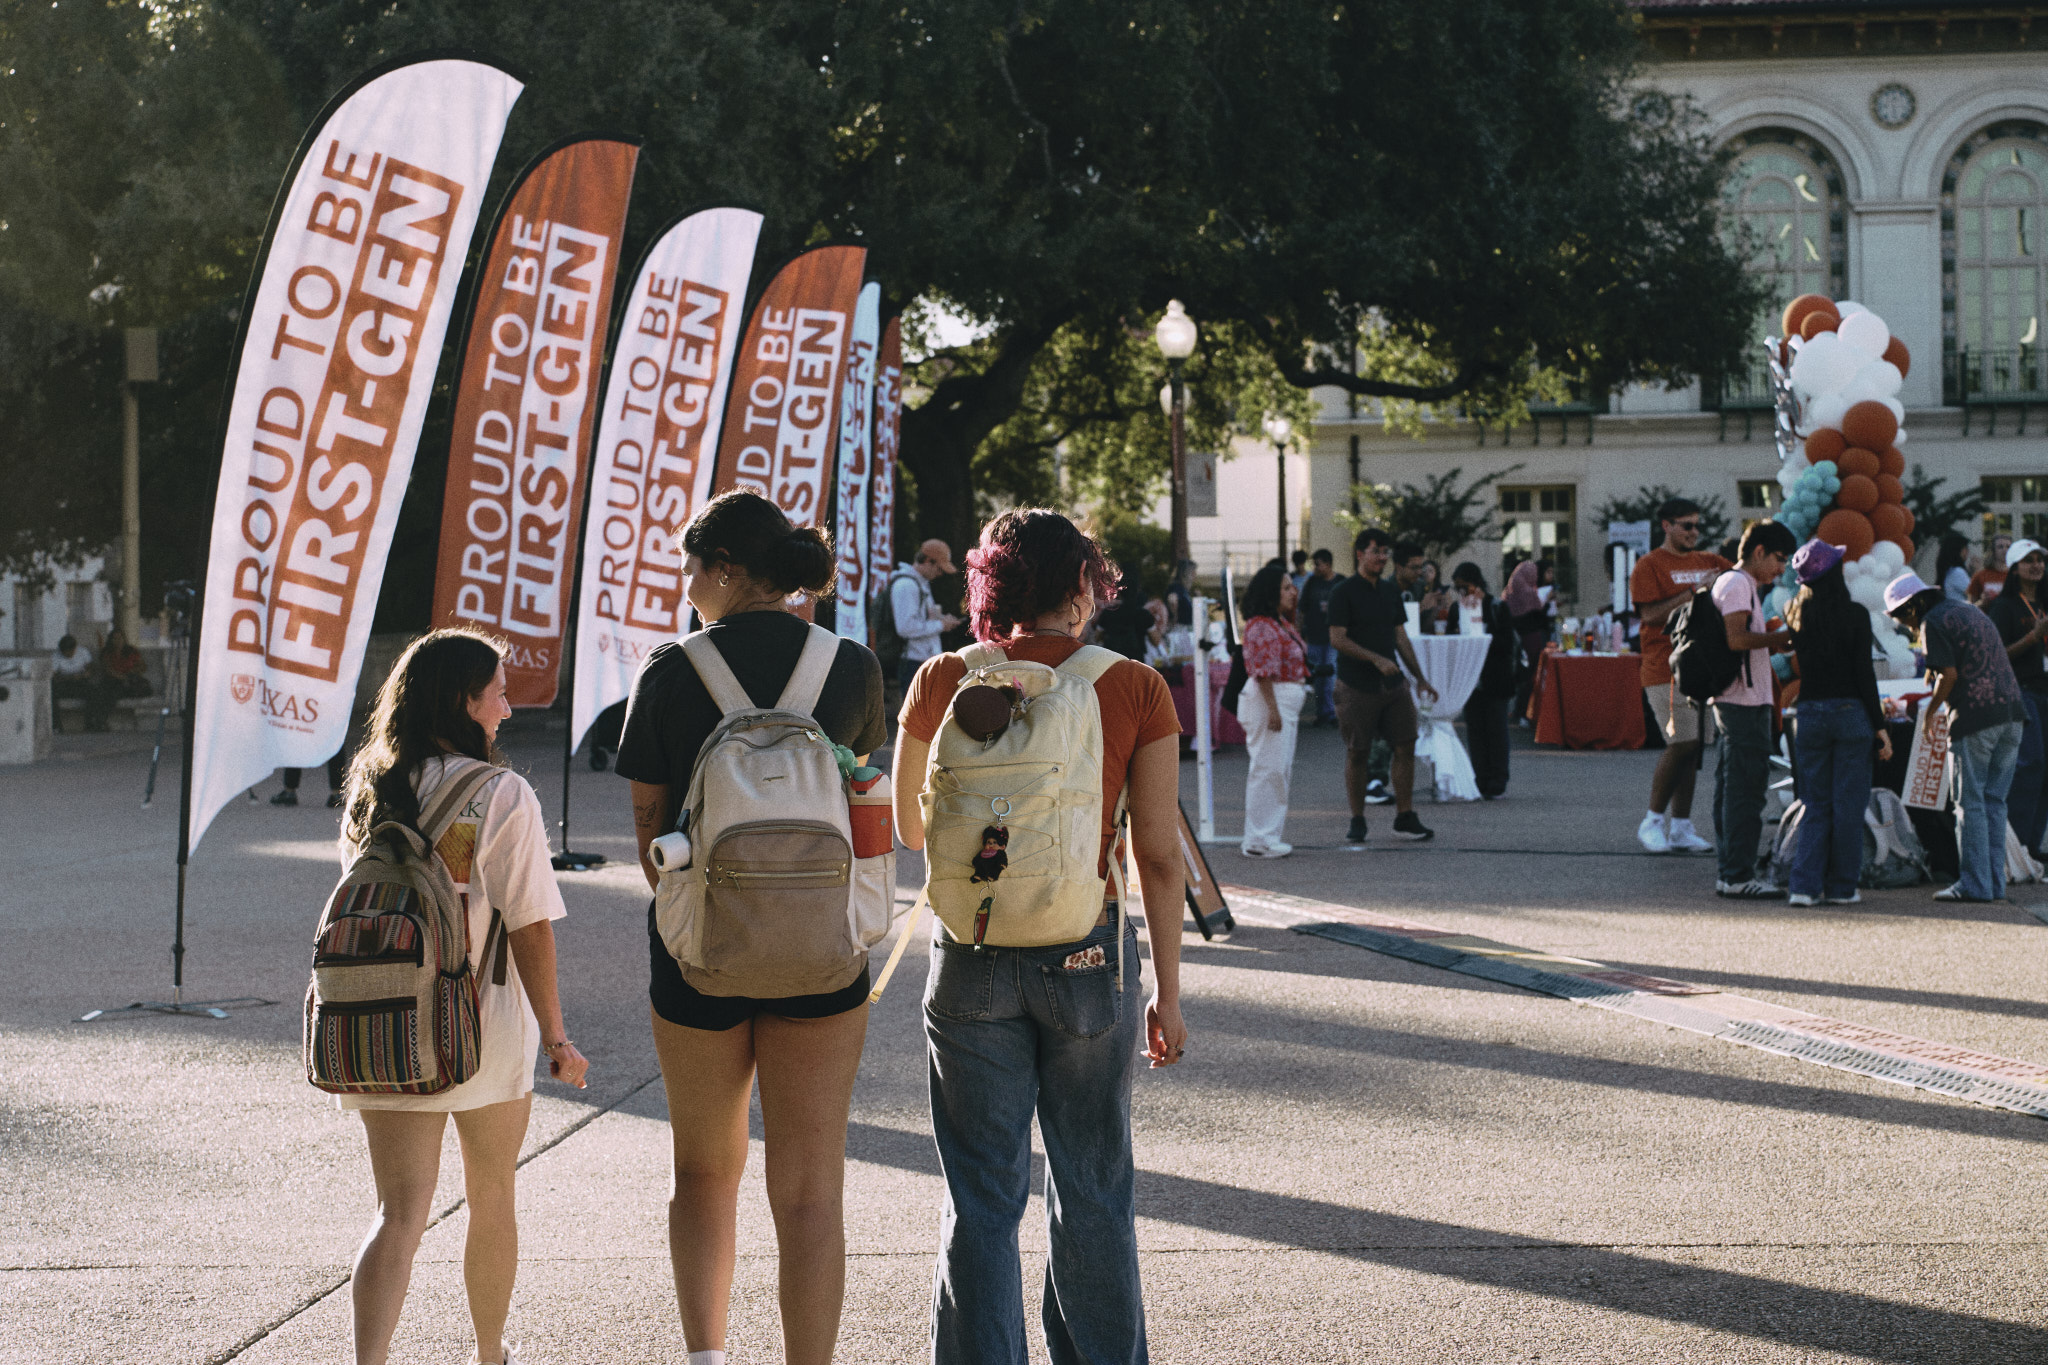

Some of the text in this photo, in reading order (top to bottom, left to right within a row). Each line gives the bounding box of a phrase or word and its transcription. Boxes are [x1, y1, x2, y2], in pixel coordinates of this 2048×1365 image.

[638, 271, 679, 341] BE
[757, 305, 795, 363] BE
[226, 386, 306, 656] PROUD
[270, 265, 342, 361] TO
[306, 139, 382, 246] BE
[268, 173, 451, 670] FIRST-GEN
[456, 214, 549, 624] PROUD TO BE
[620, 356, 661, 422] TO
[743, 375, 784, 434] TO
[776, 318, 838, 526] ST-GEN
[509, 236, 599, 628] FIRST-GEN
[631, 289, 722, 627] FIRST-GEN
[595, 439, 644, 622] PROUD
[506, 643, 550, 670] XAS
[258, 678, 319, 724] TXAS
[459, 801, 483, 819] K
[1909, 756, 1928, 804] PROUD
